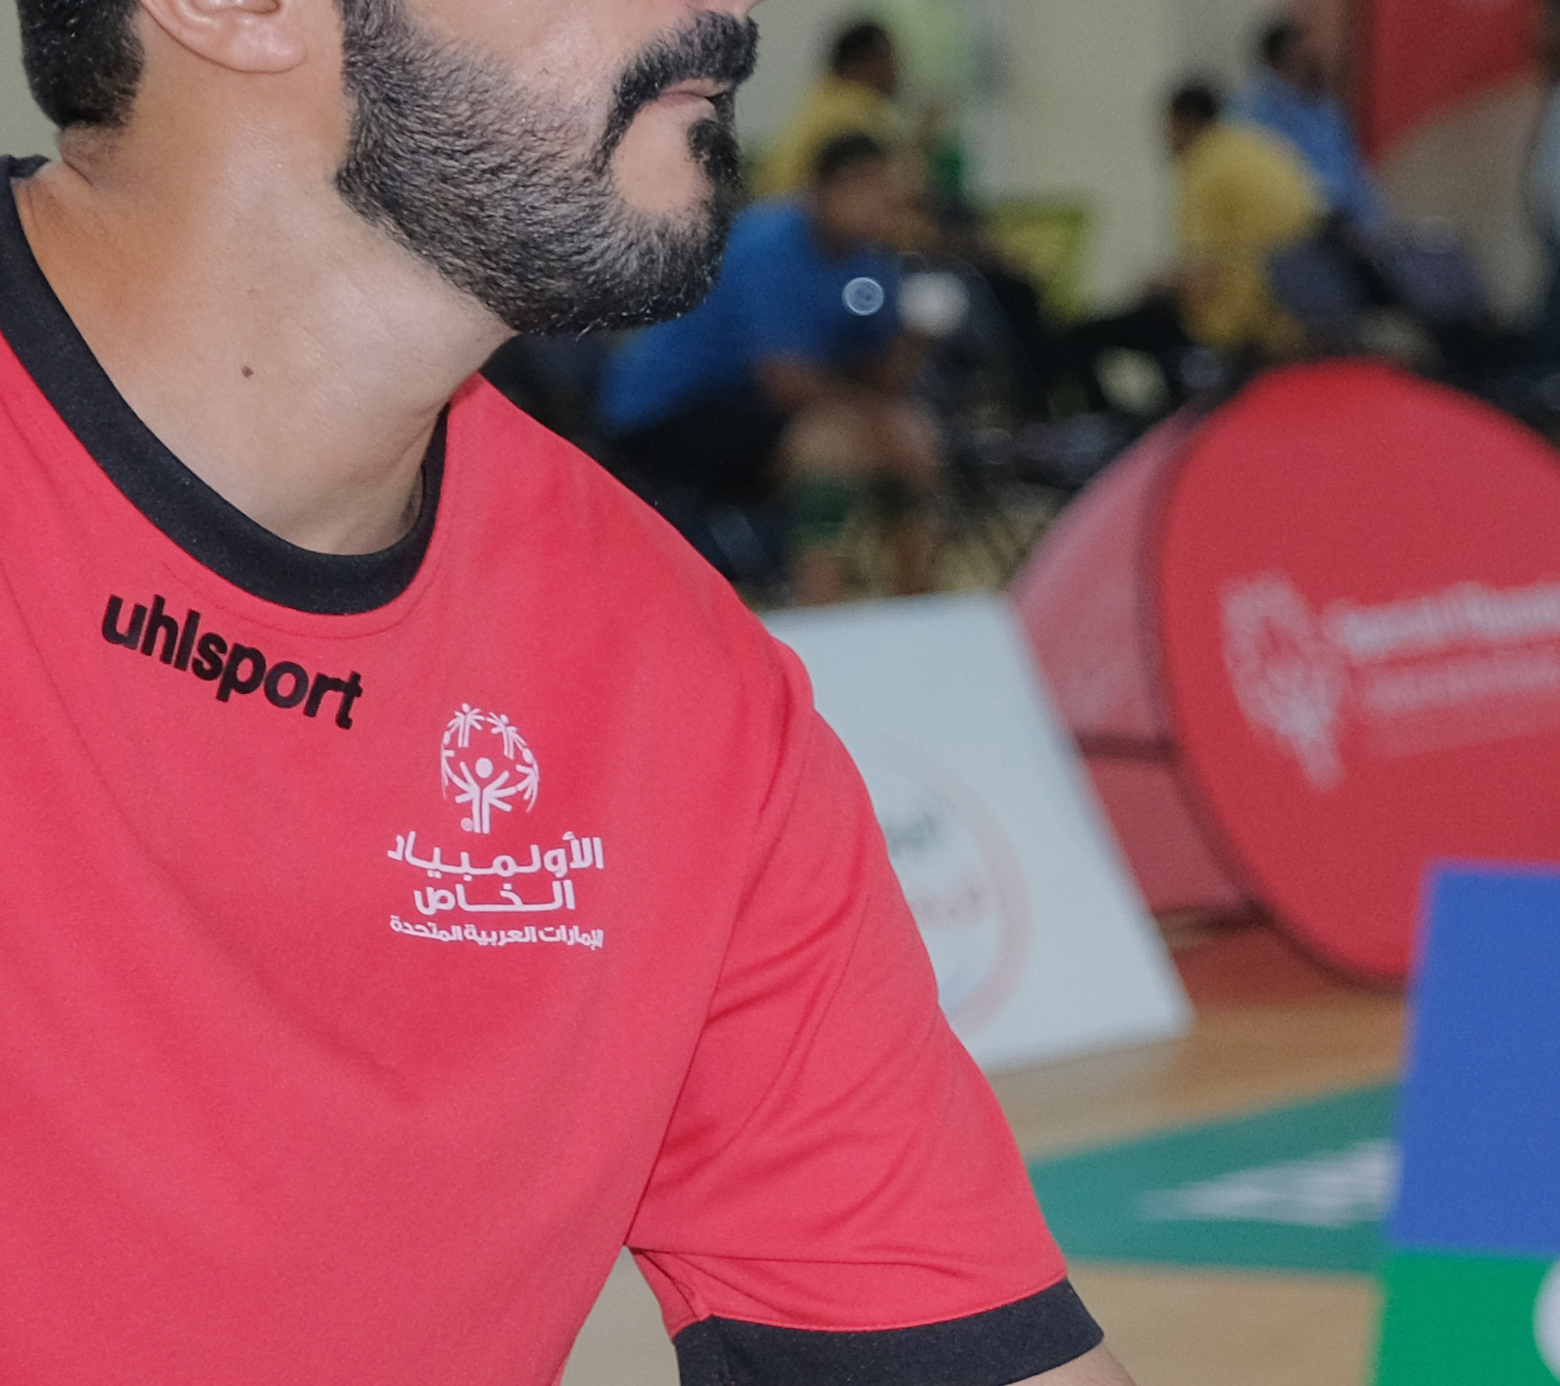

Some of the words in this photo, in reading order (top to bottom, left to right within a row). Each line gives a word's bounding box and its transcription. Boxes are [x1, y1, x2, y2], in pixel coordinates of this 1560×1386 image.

[102, 594, 363, 730] uhlsport
[387, 831, 604, 882] الأولمبياد
[414, 879, 576, 916] الخاص
[389, 914, 464, 942] المتحدة
[464, 923, 538, 947] العربية
